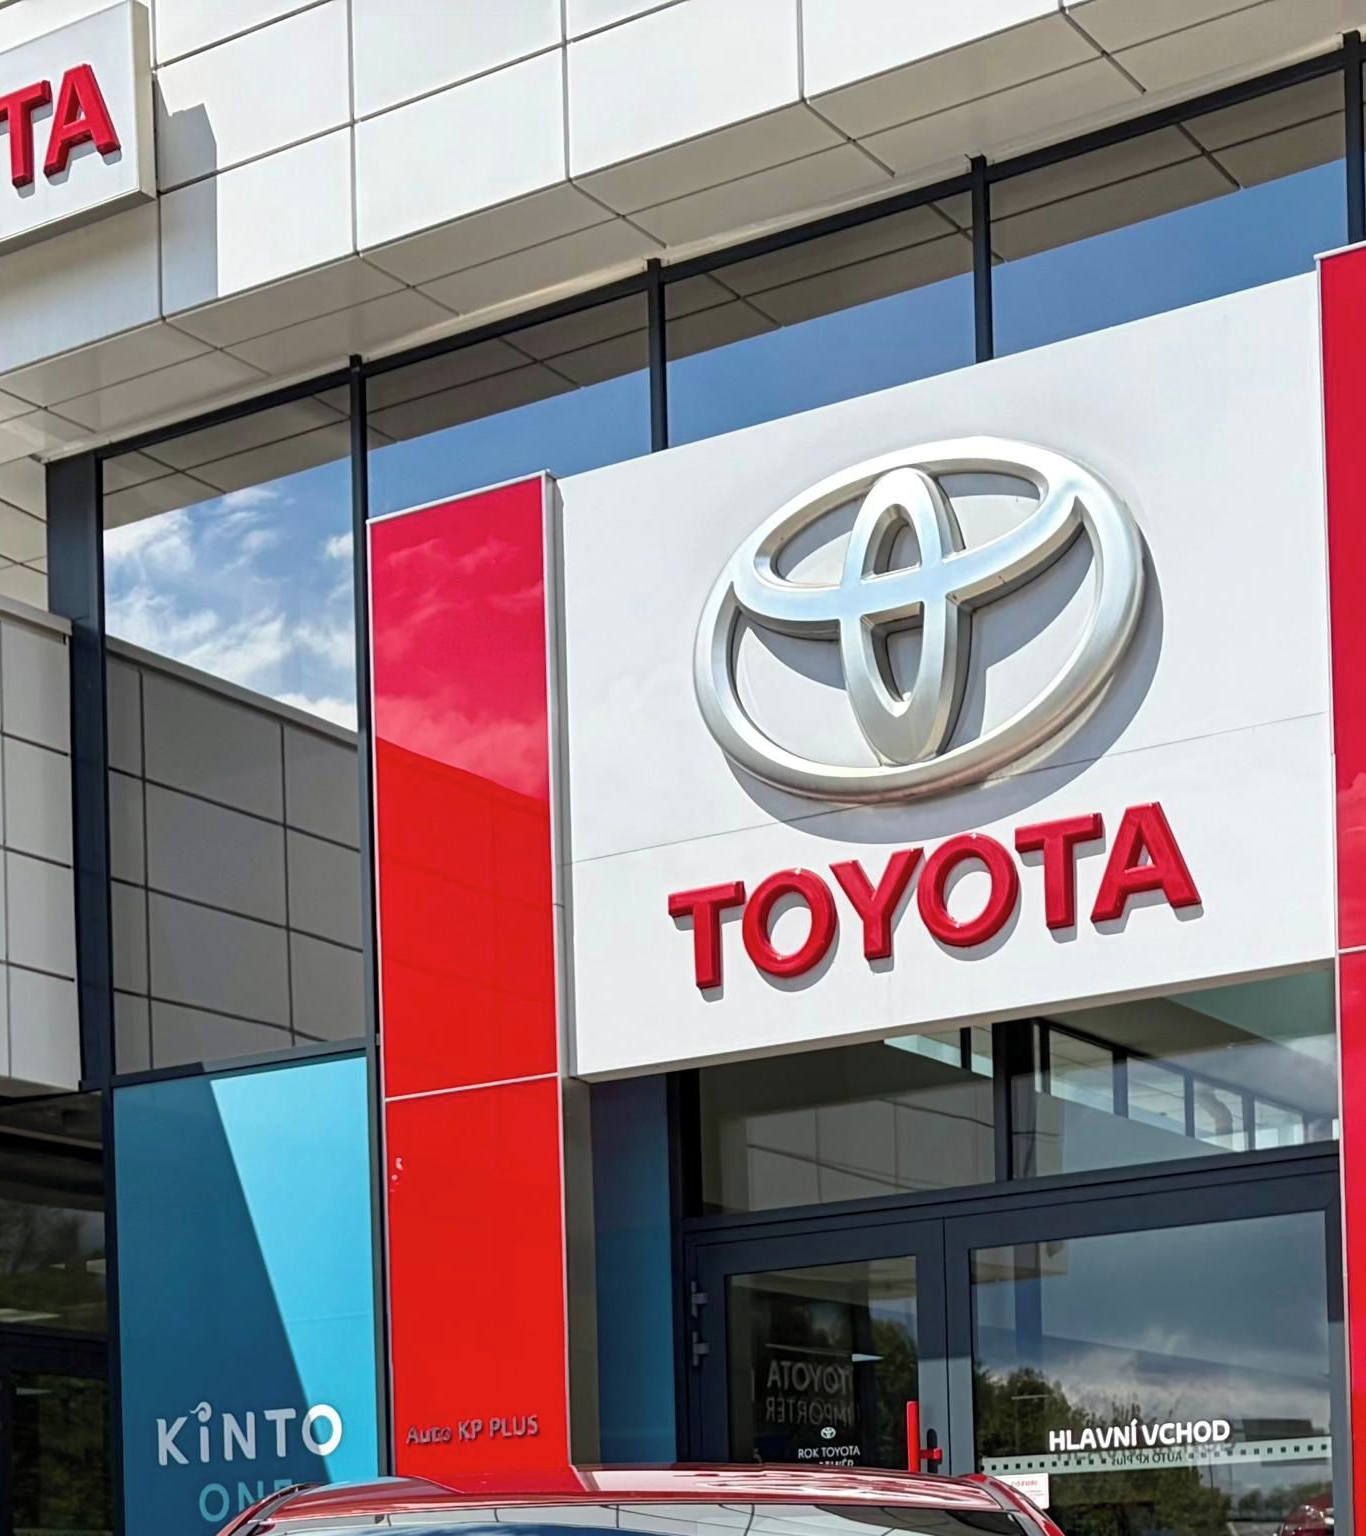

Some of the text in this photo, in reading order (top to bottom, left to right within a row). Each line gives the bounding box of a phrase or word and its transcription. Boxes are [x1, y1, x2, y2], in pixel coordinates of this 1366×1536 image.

[668, 801, 1202, 990] TOYOTA
[406, 1415, 539, 1445] Auto KP PLUS
[1048, 1419, 1231, 1451] HLAVNÍ VCHOD
[797, 1445, 861, 1459] ROK TOYOTA
